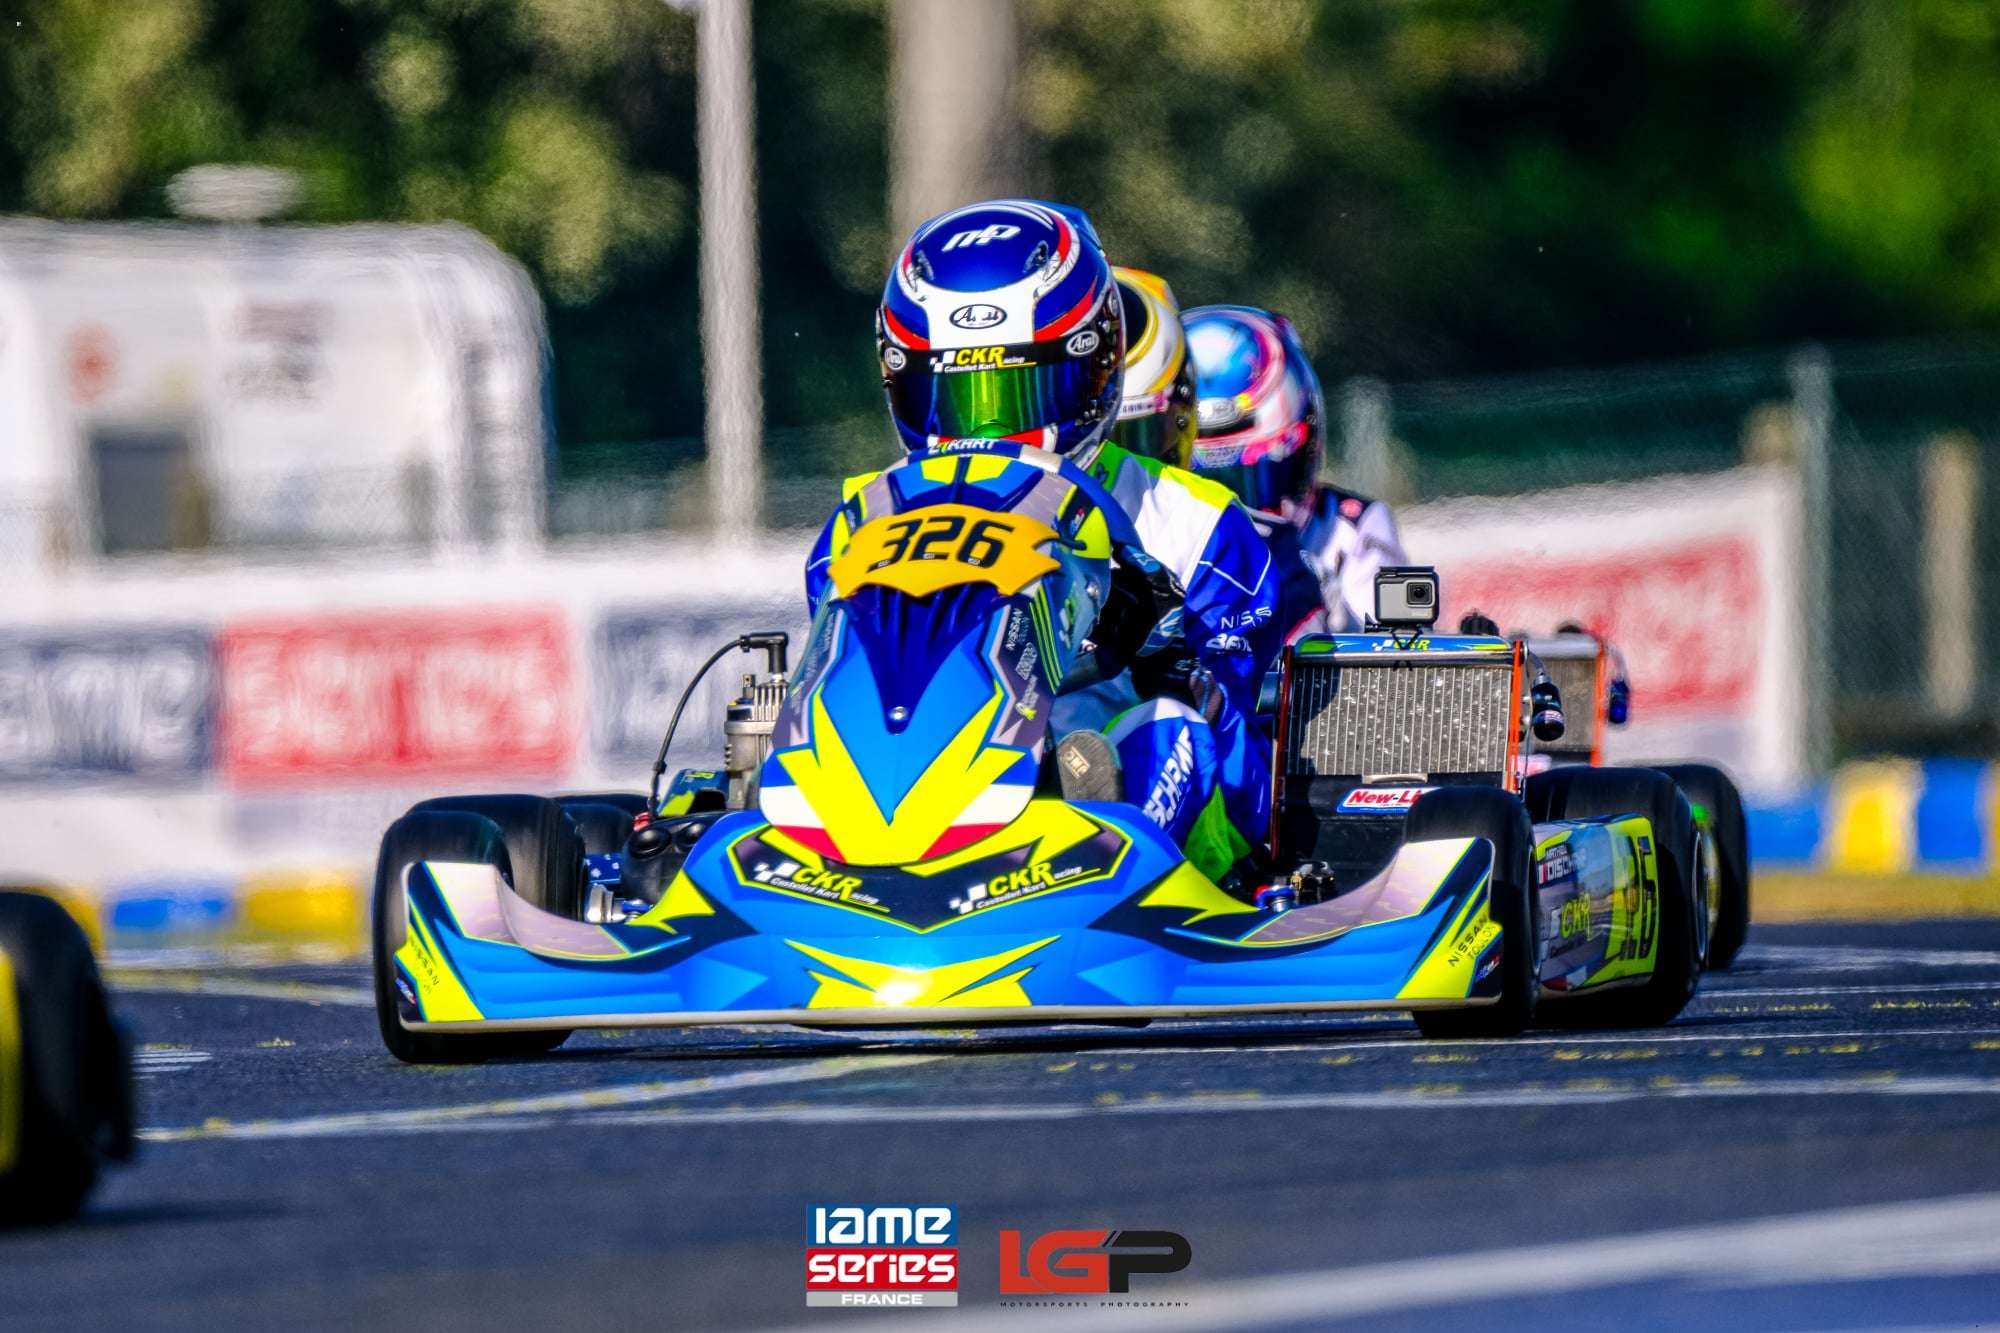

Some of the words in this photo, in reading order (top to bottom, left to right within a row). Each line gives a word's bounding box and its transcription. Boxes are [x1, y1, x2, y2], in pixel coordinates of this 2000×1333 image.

[956, 347, 1006, 368] CKR
[866, 515, 1016, 574] 326
[792, 867, 863, 900] CKR
[988, 862, 1057, 896] CKR
[1447, 914, 1487, 967] NISSAN
